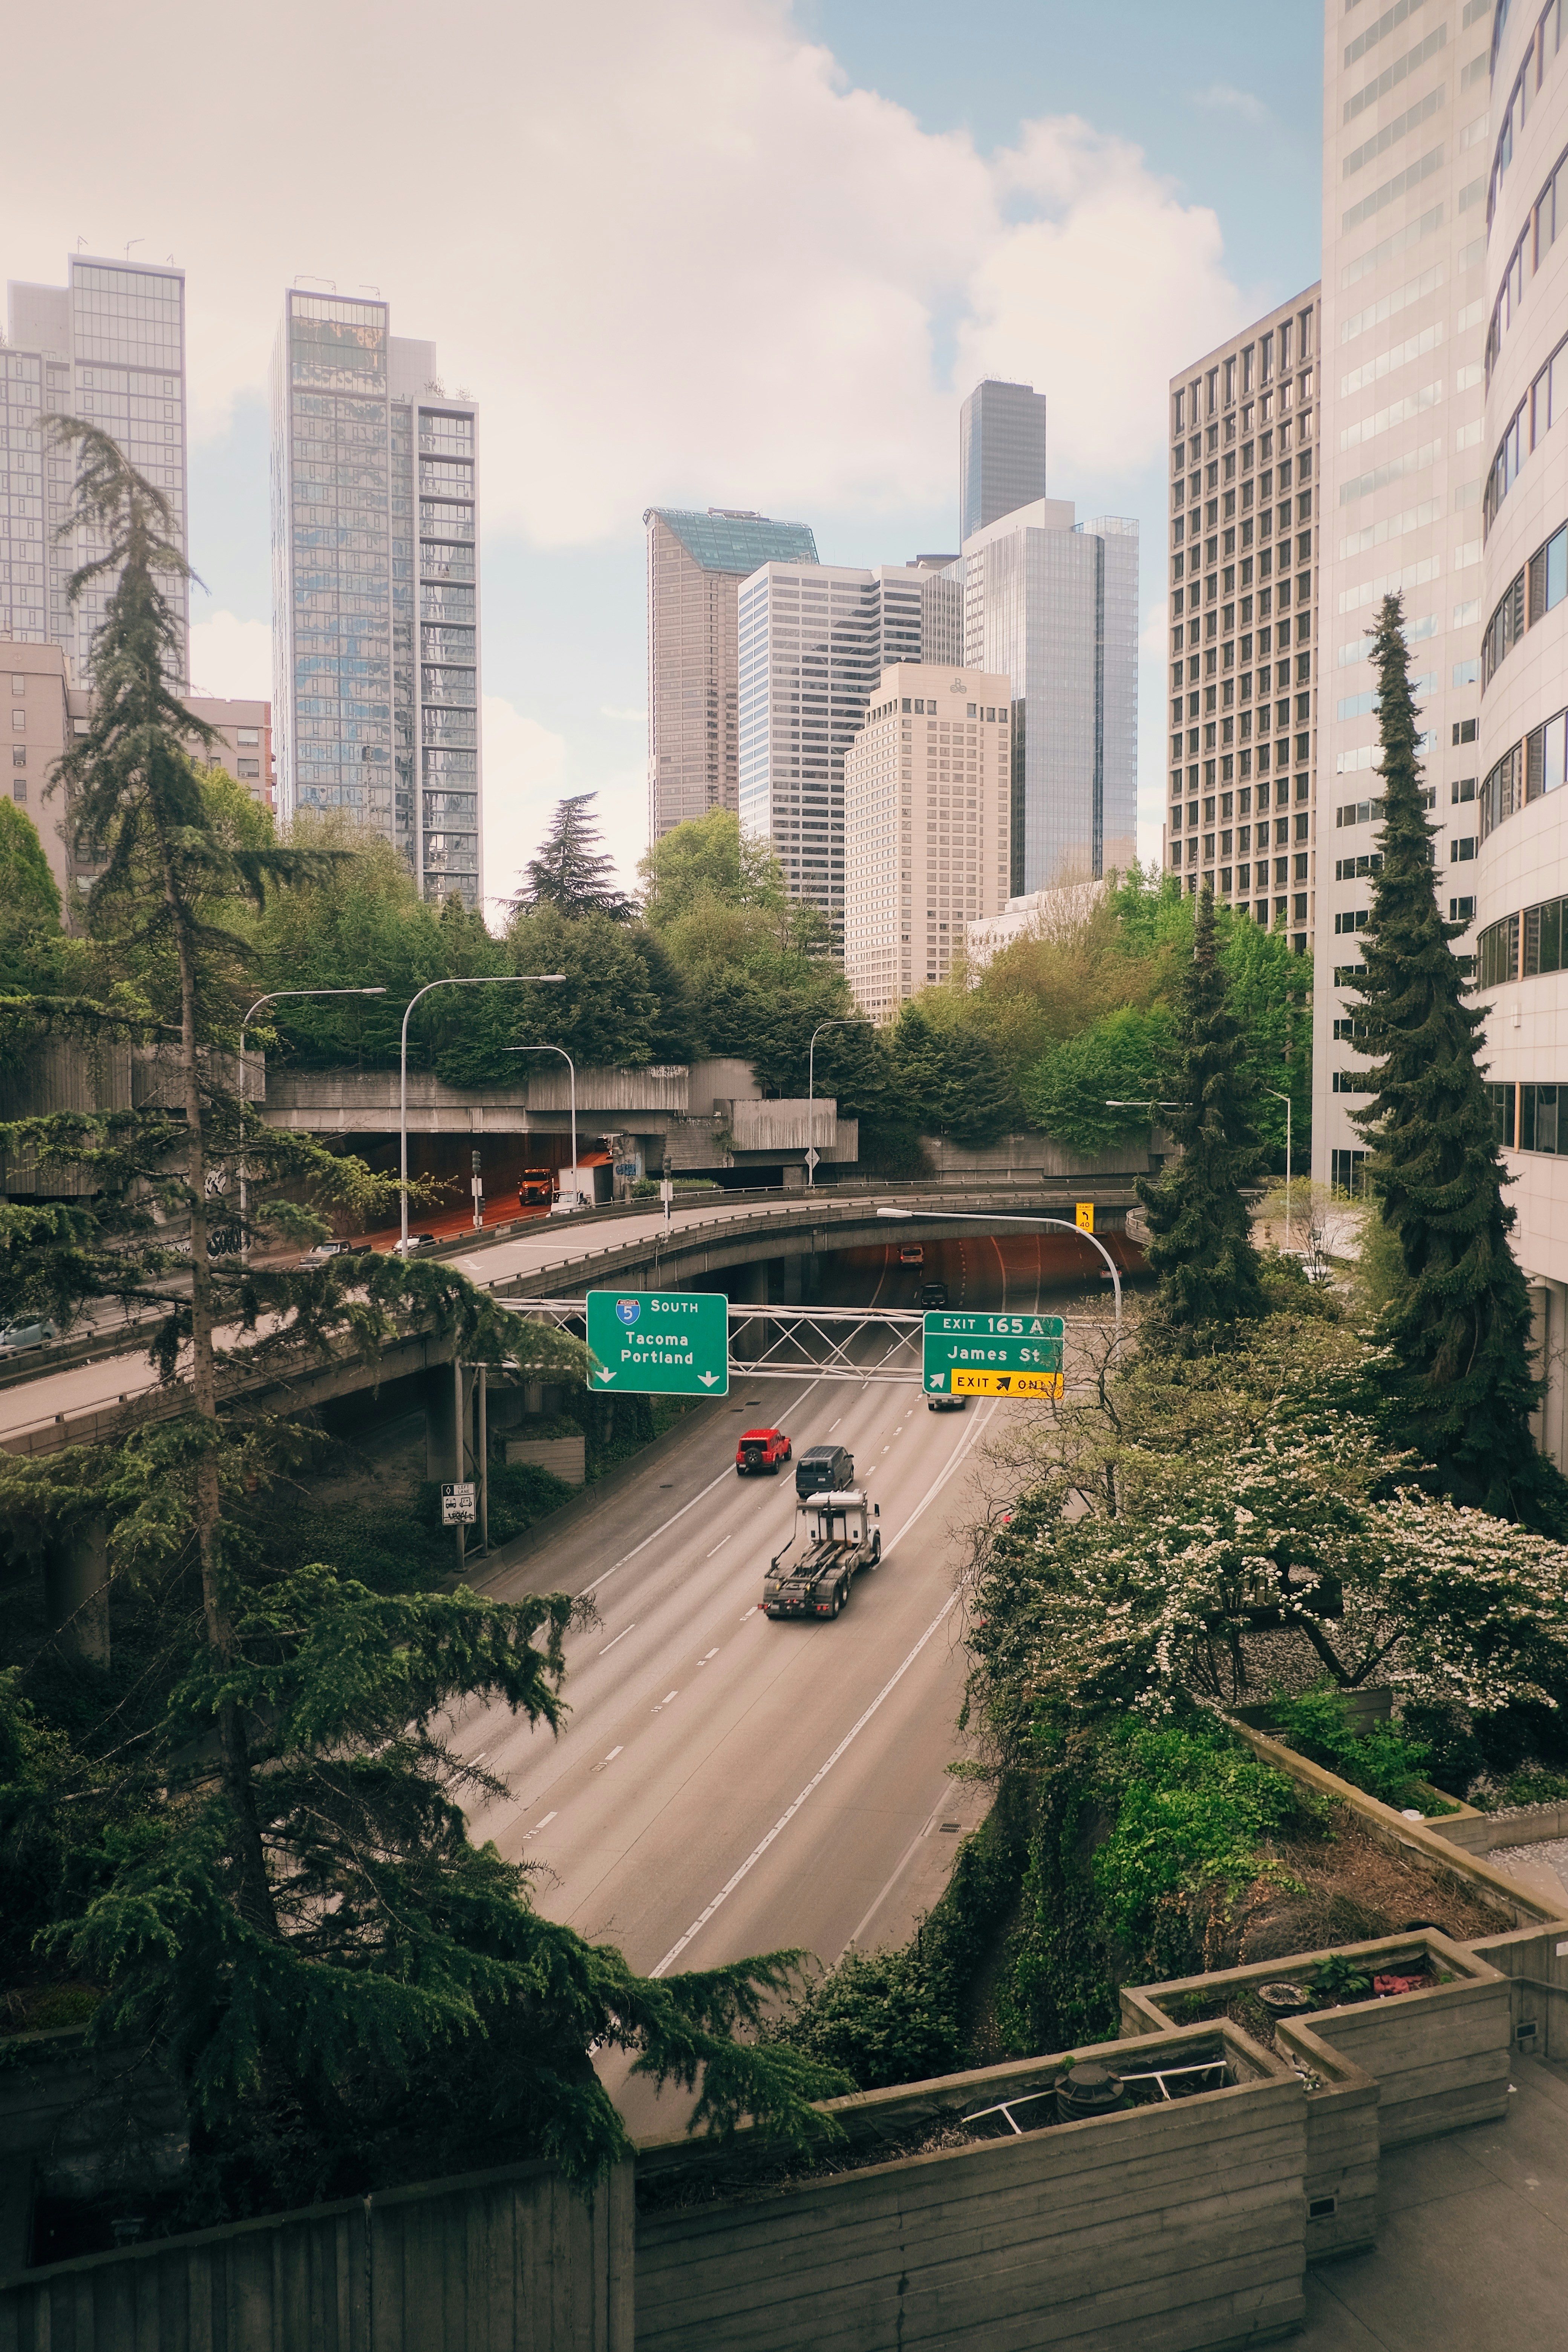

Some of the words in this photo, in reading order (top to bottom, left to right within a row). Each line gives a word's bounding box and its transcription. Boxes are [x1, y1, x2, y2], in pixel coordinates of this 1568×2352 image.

[624, 1306, 632, 1320] 5
[651, 1300, 698, 1312] SOUTH
[943, 1318, 975, 1329] EXIT
[626, 1331, 688, 1346] Tacoma
[621, 1349, 693, 1364] Portland
[947, 1346, 1007, 1360] James
[1019, 1348, 1040, 1362] St
[958, 1377, 989, 1387] EXIT
